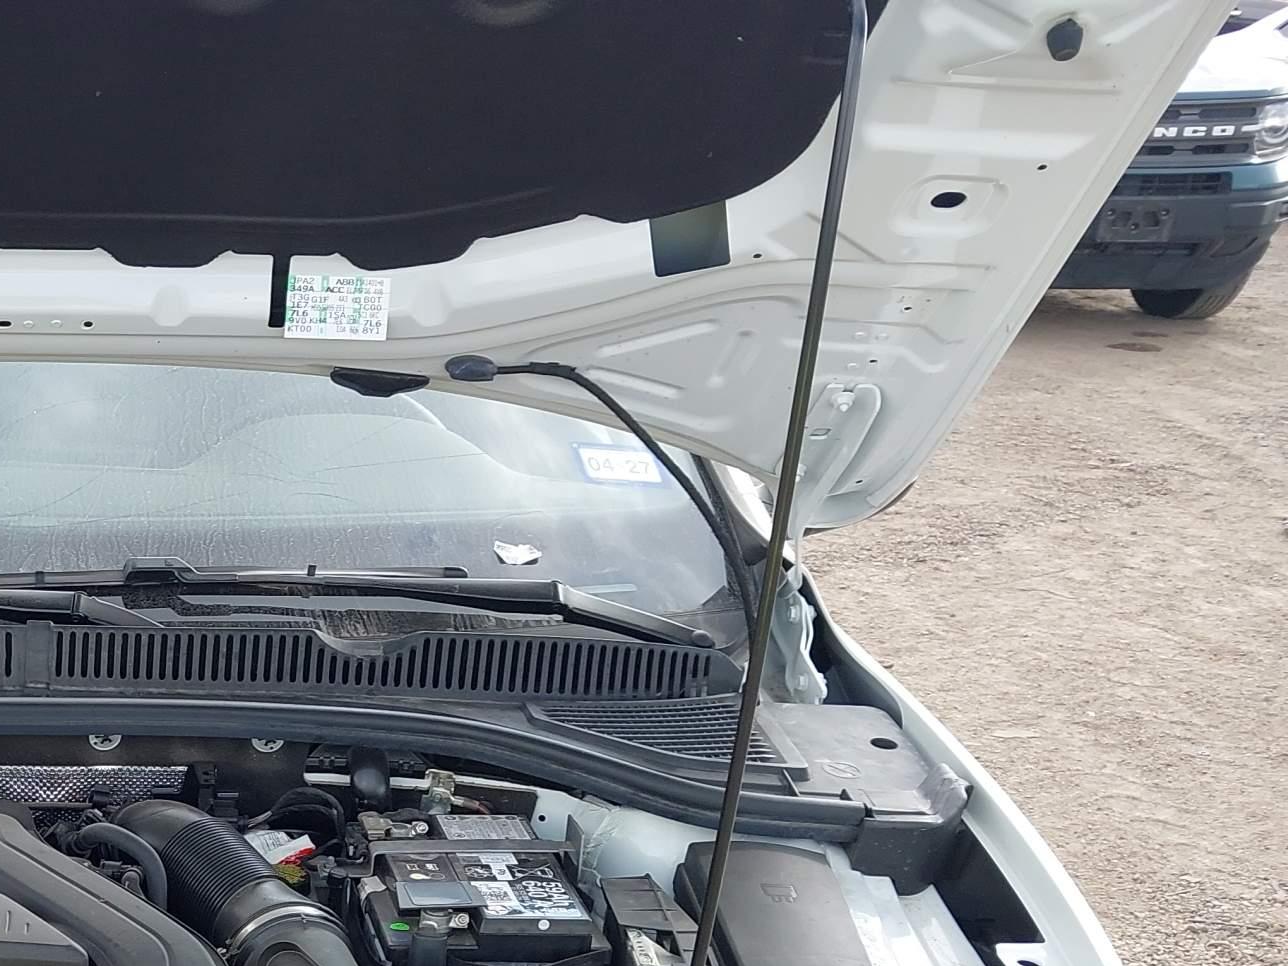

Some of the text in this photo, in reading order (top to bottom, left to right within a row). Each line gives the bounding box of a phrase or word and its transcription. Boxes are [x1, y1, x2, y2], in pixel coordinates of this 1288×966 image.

[1153, 125, 1236, 138] NCO
[587, 456, 650, 474] 04 27
